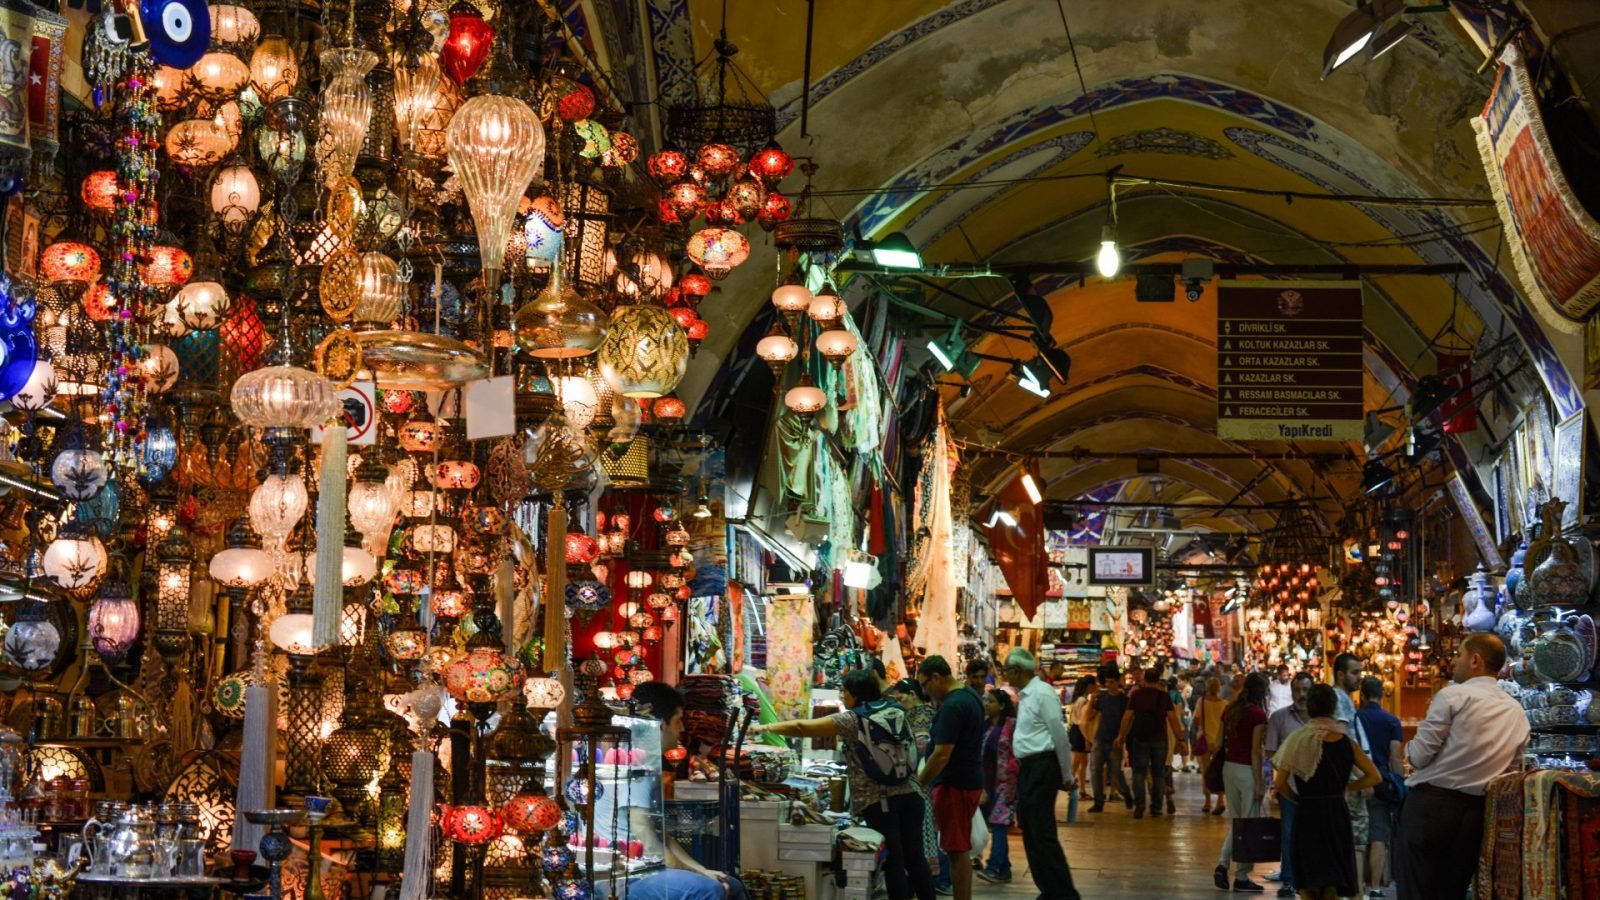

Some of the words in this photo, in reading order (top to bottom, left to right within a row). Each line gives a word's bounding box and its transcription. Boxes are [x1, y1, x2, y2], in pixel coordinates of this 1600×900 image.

[1239, 322, 1272, 332] DİVRİKLİ
[1273, 324, 1287, 332] SK.
[1239, 340, 1271, 349] KOLTUK
[1273, 341, 1315, 349] KAZAZLAR
[1317, 341, 1330, 349] SK.
[1239, 357, 1261, 366] ORTA
[1263, 357, 1305, 366] KAZAZLAR
[1307, 358, 1320, 366] SK.
[1239, 374, 1281, 382] KAZAZLAR
[1283, 374, 1296, 383] SK.
[1239, 391, 1272, 399] RESSAM
[1274, 391, 1326, 400] BASMACILAR
[1328, 391, 1342, 400] SK.
[1239, 405, 1294, 416] FERACECİLER
[1296, 408, 1309, 416] SK.
[1278, 424, 1332, 438] YapıKredi
